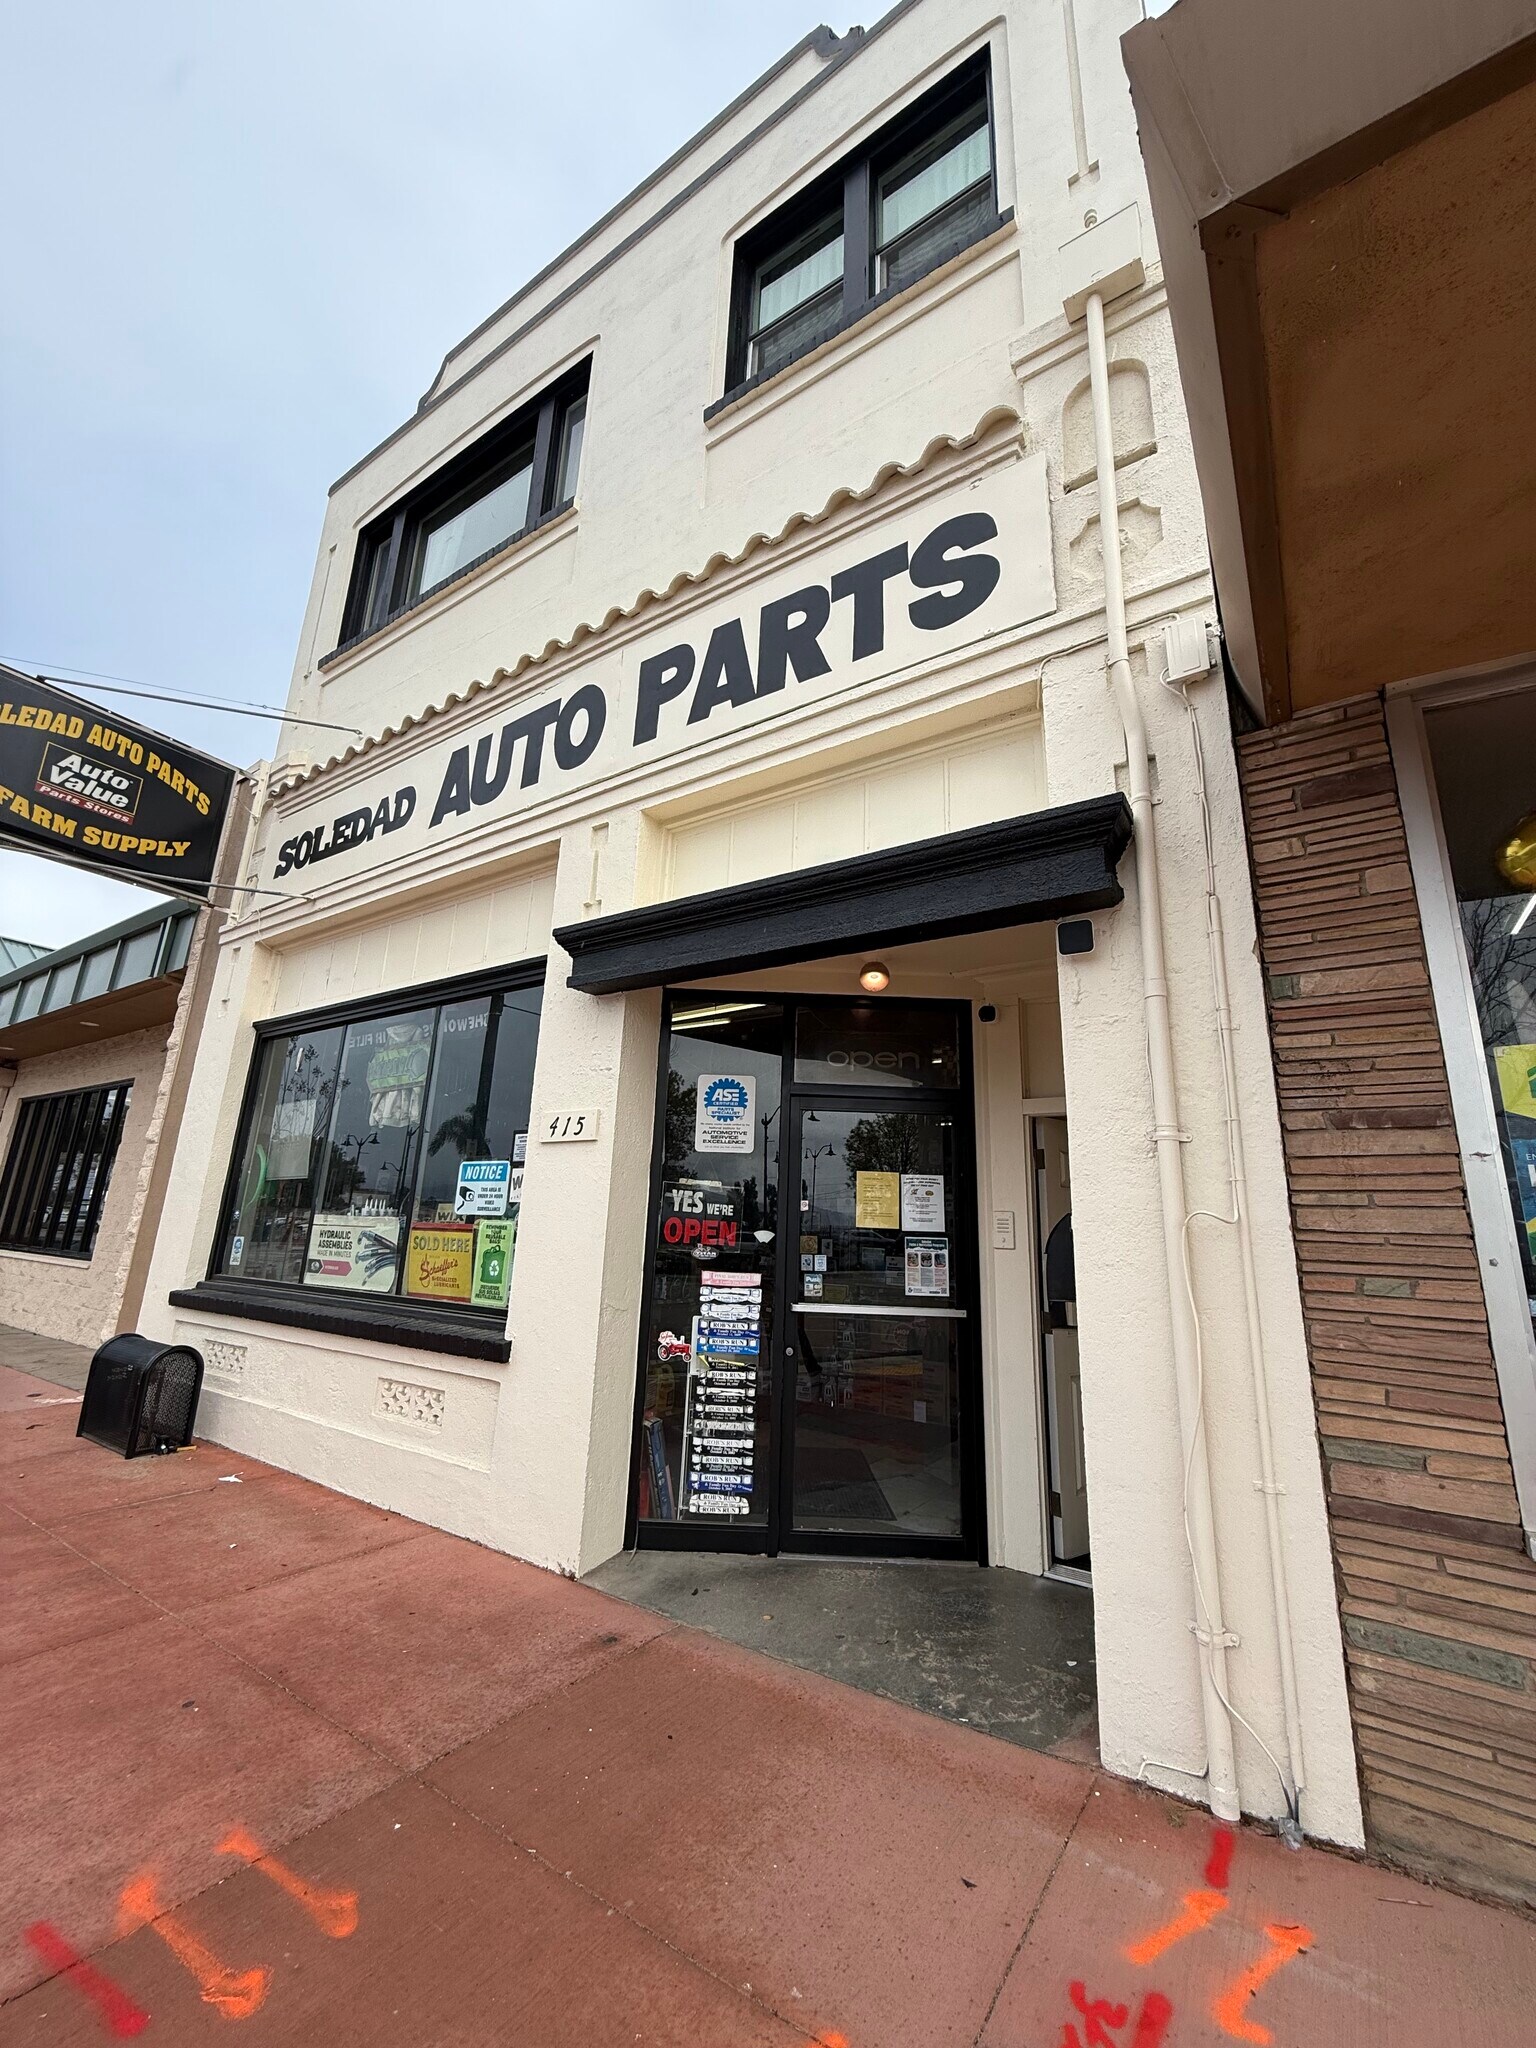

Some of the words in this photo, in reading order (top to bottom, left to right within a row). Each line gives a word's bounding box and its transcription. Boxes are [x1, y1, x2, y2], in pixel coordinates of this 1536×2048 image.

[272, 786, 417, 879] SOLEDAD
[429, 684, 607, 829] AUTO
[632, 512, 1001, 746] PARTS
[0, 703, 84, 739] LEDAD
[86, 724, 143, 766] AUTO
[146, 751, 211, 816] PARTS
[57, 754, 130, 790] Auto
[50, 765, 129, 808] Value
[40, 785, 81, 805] Parts
[84, 801, 130, 822] Stores
[0, 784, 77, 838] FARM
[83, 826, 191, 857] SUPPLY
[827, 1051, 920, 1072] open
[711, 1088, 739, 1101] ASE
[549, 1116, 586, 1138] 415
[465, 1165, 503, 1180] NOTICE
[672, 1189, 703, 1213] YES
[707, 1203, 734, 1216] WE'RE
[319, 1230, 351, 1239] HYDRAULIC
[664, 1217, 737, 1246] OPEN
[318, 1240, 352, 1250] ASSEMBLIES
[413, 1236, 439, 1251] SOLD
[442, 1237, 470, 1253] HERE
